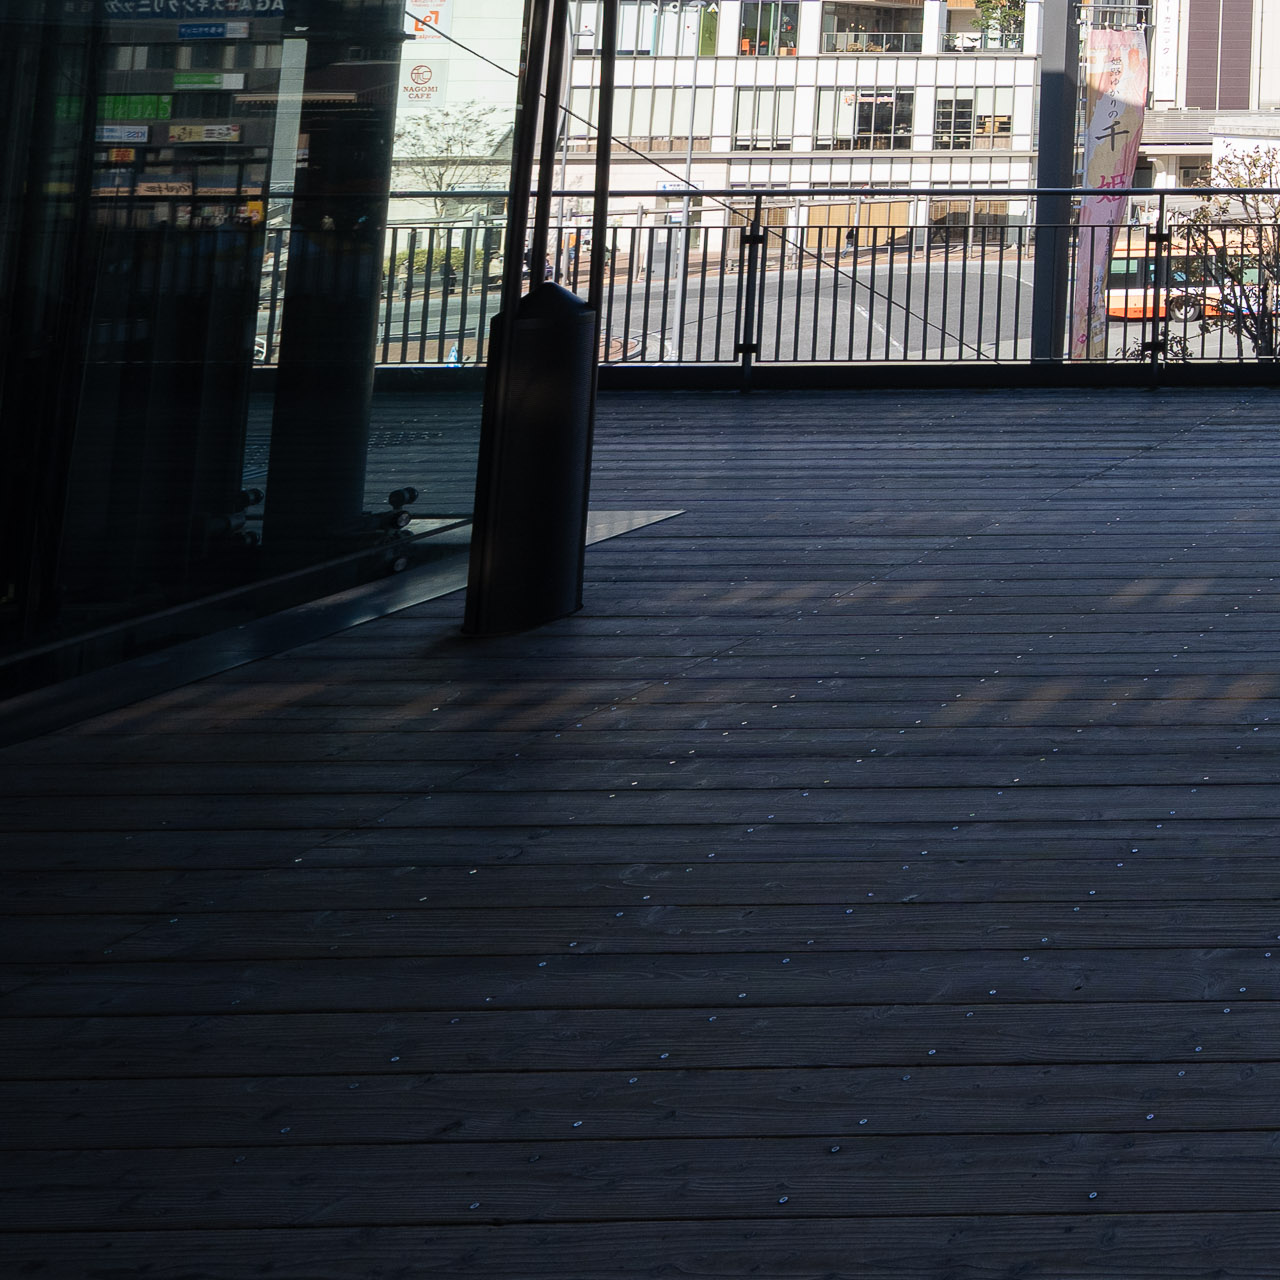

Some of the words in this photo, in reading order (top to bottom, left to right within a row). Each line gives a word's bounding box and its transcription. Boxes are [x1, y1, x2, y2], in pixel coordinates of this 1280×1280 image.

[1107, 56, 1122, 119] 姫路ゆかりの
